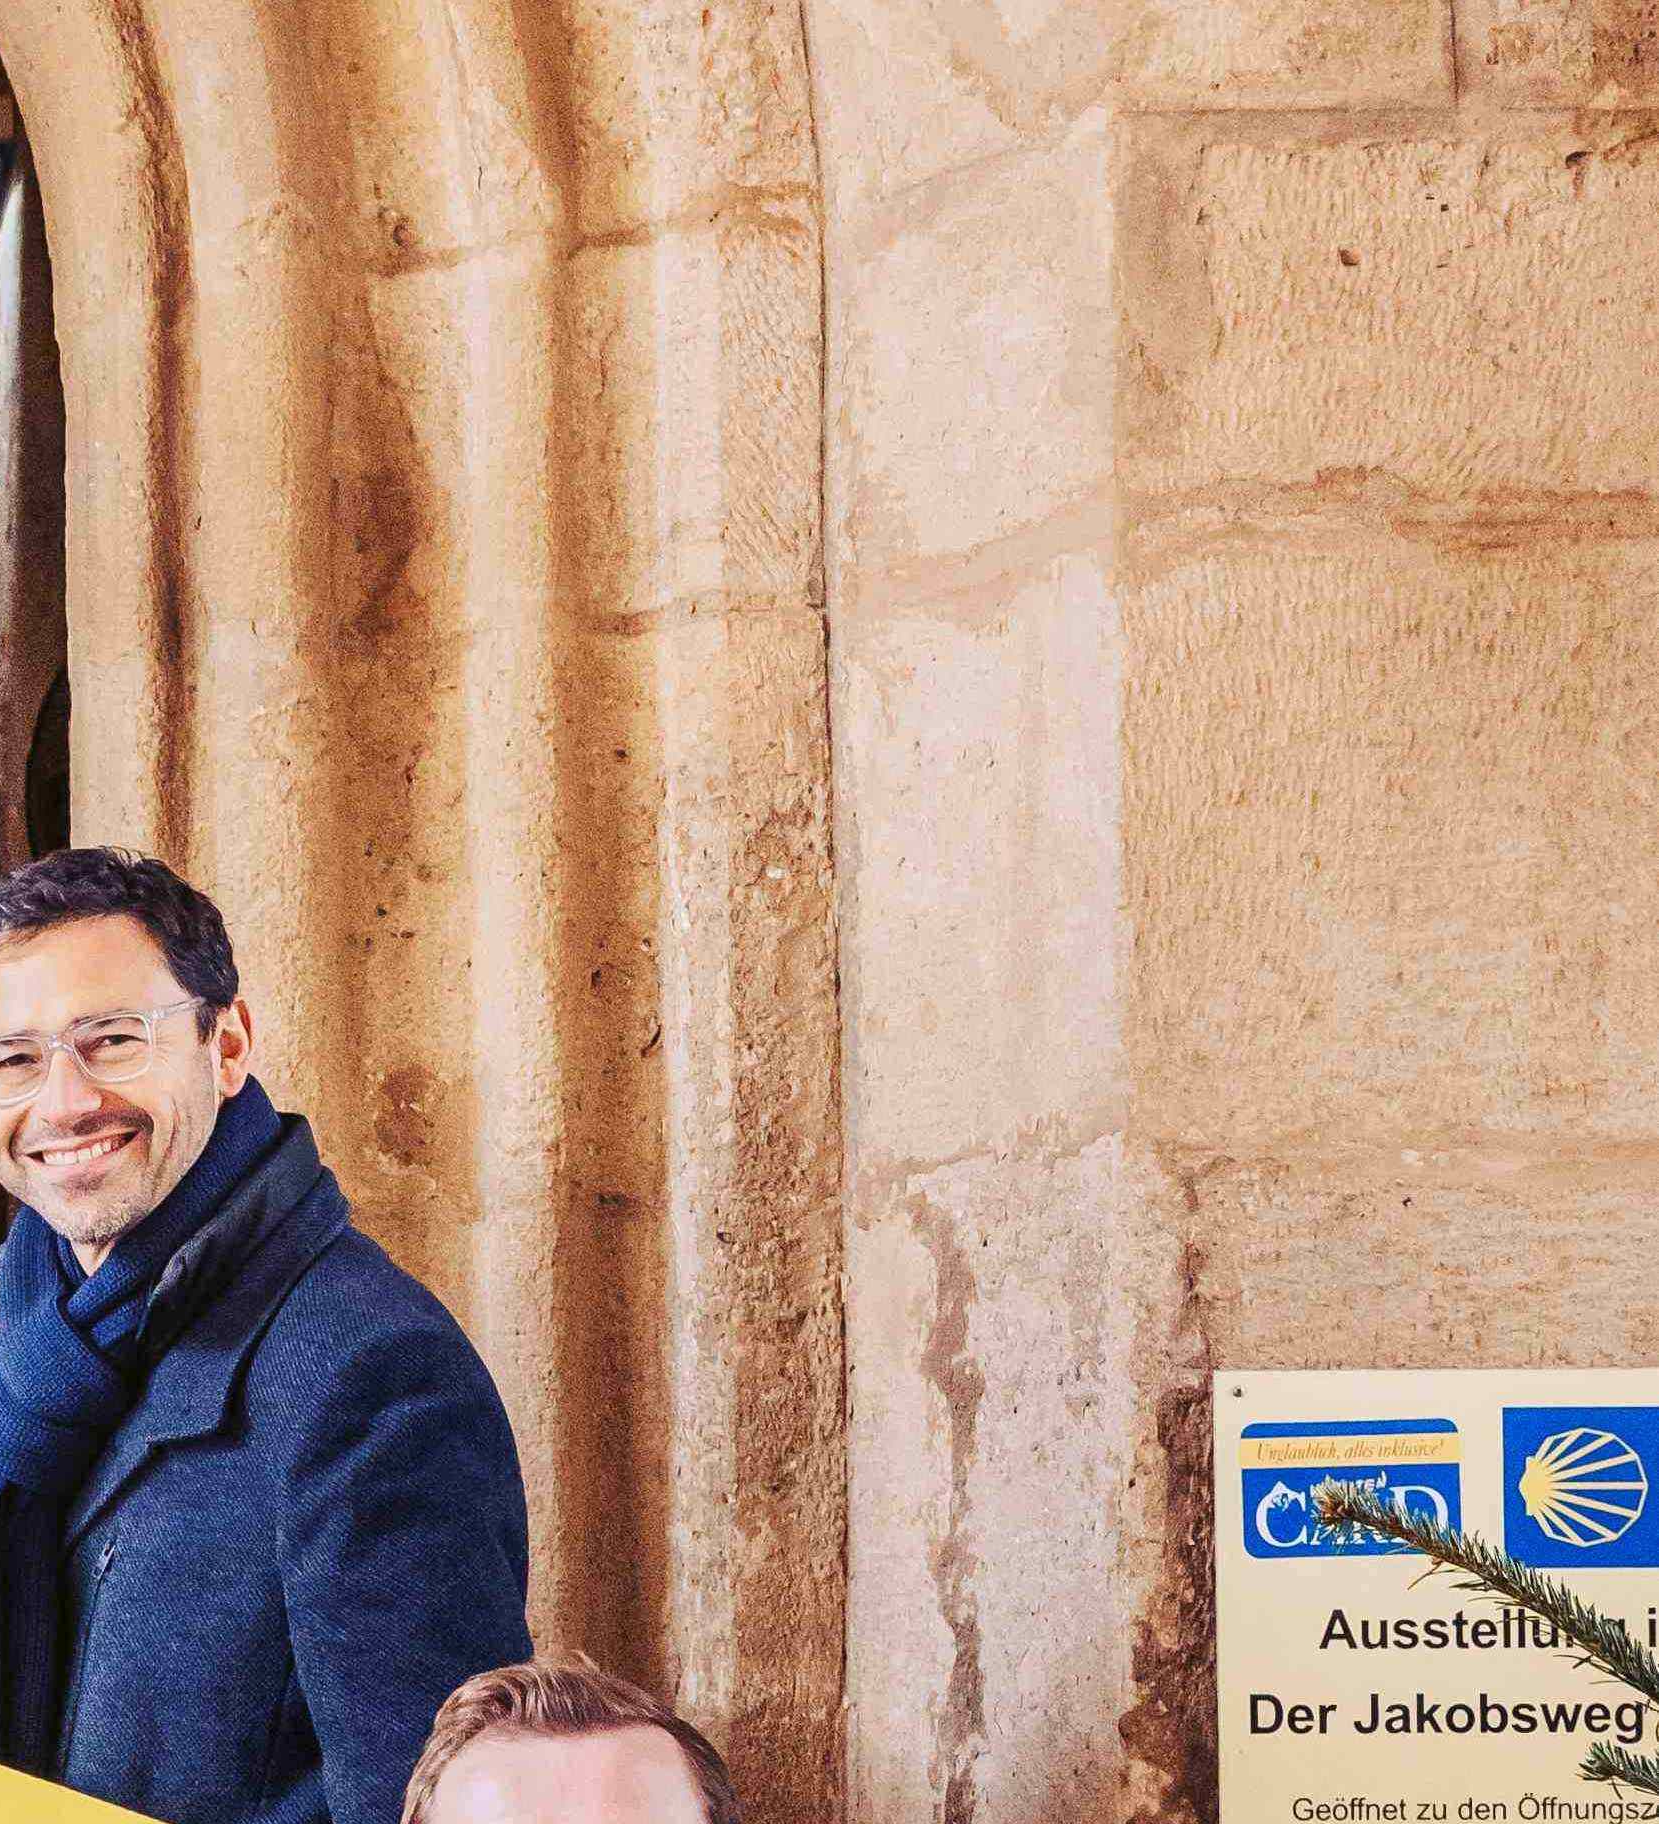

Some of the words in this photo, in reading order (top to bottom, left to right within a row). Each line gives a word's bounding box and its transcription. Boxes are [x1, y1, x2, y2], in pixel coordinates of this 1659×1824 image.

[1256, 1441, 1340, 1463] Unglaublich,
[1344, 1440, 1373, 1460] alles
[1378, 1438, 1445, 1459] inklusive!
[1319, 1608, 1626, 1650] Ausstellu
[1248, 1692, 1338, 1736] Der
[1352, 1692, 1645, 1745] Jakobsweg
[1292, 1796, 1408, 1822] Geöffnet
[1416, 1803, 1448, 1821] zu
[1458, 1796, 1507, 1821] den
